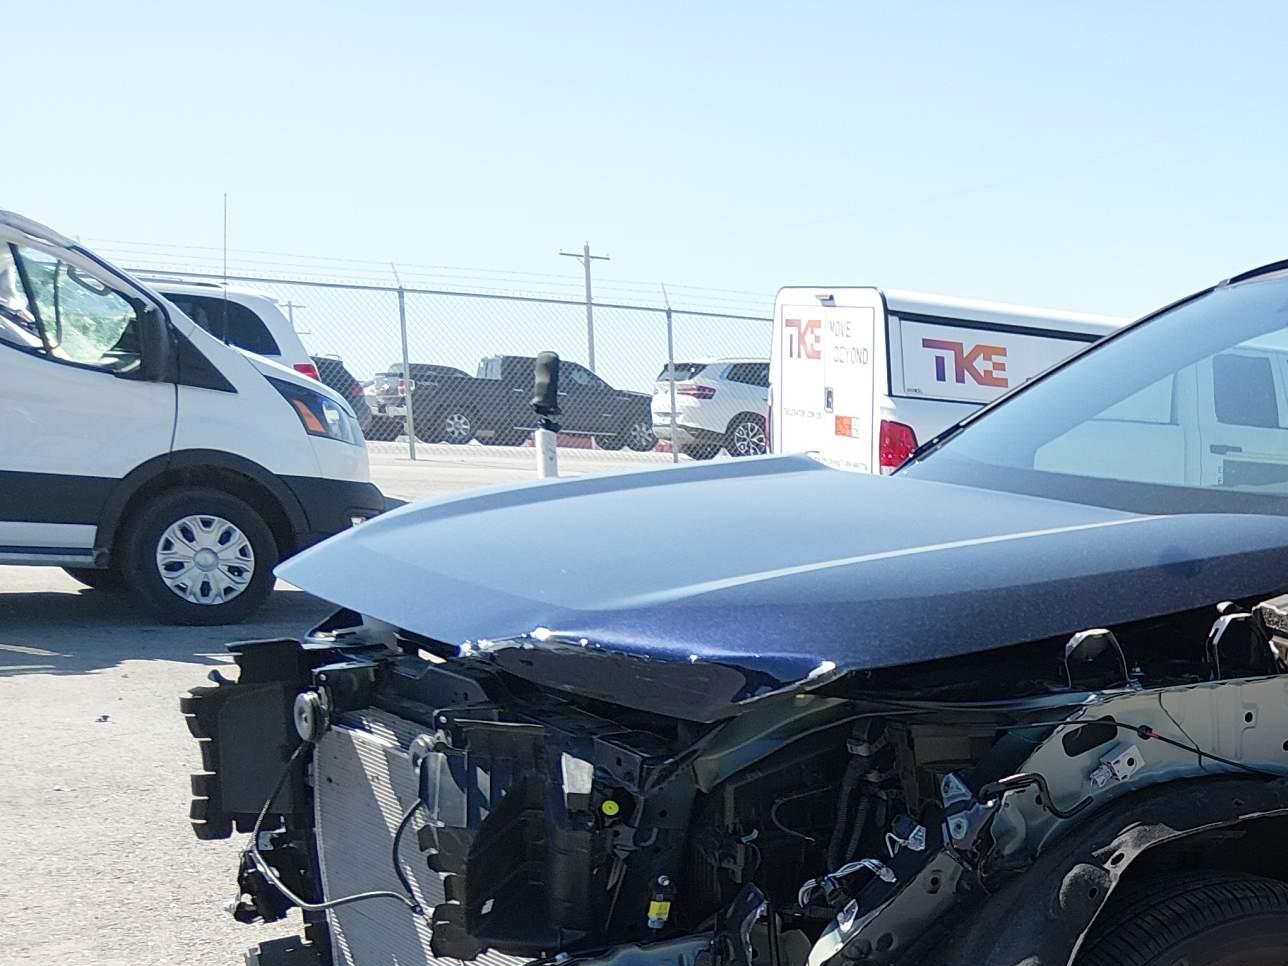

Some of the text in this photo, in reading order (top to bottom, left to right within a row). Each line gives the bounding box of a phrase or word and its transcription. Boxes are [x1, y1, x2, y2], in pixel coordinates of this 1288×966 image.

[785, 318, 822, 360] TKE
[829, 320, 853, 339] MOVE
[922, 337, 1009, 389] TKE
